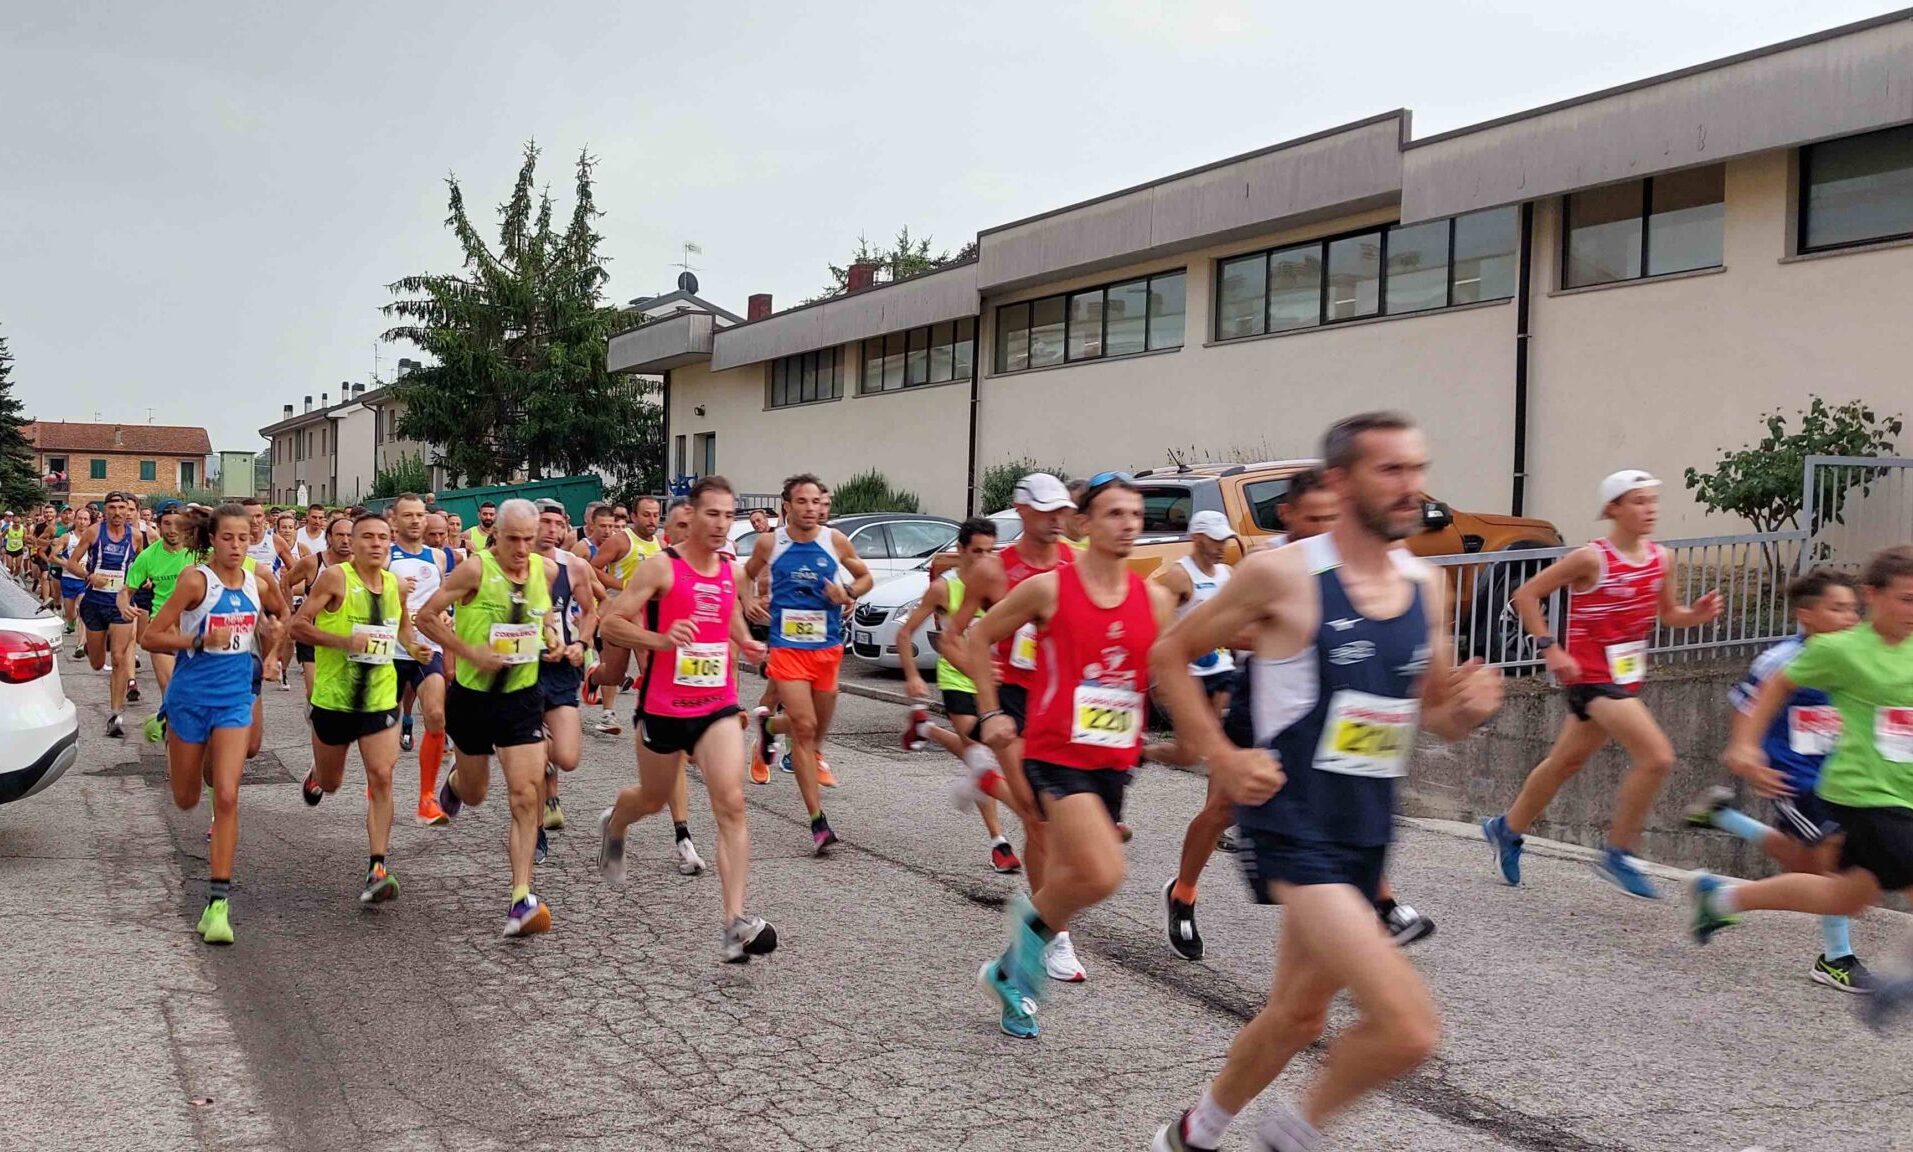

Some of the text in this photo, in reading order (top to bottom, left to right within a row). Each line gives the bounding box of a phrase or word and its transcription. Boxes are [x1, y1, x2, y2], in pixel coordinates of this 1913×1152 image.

[795, 621, 813, 635] 82
[513, 638, 520, 654] 1
[691, 658, 721, 676] 106
